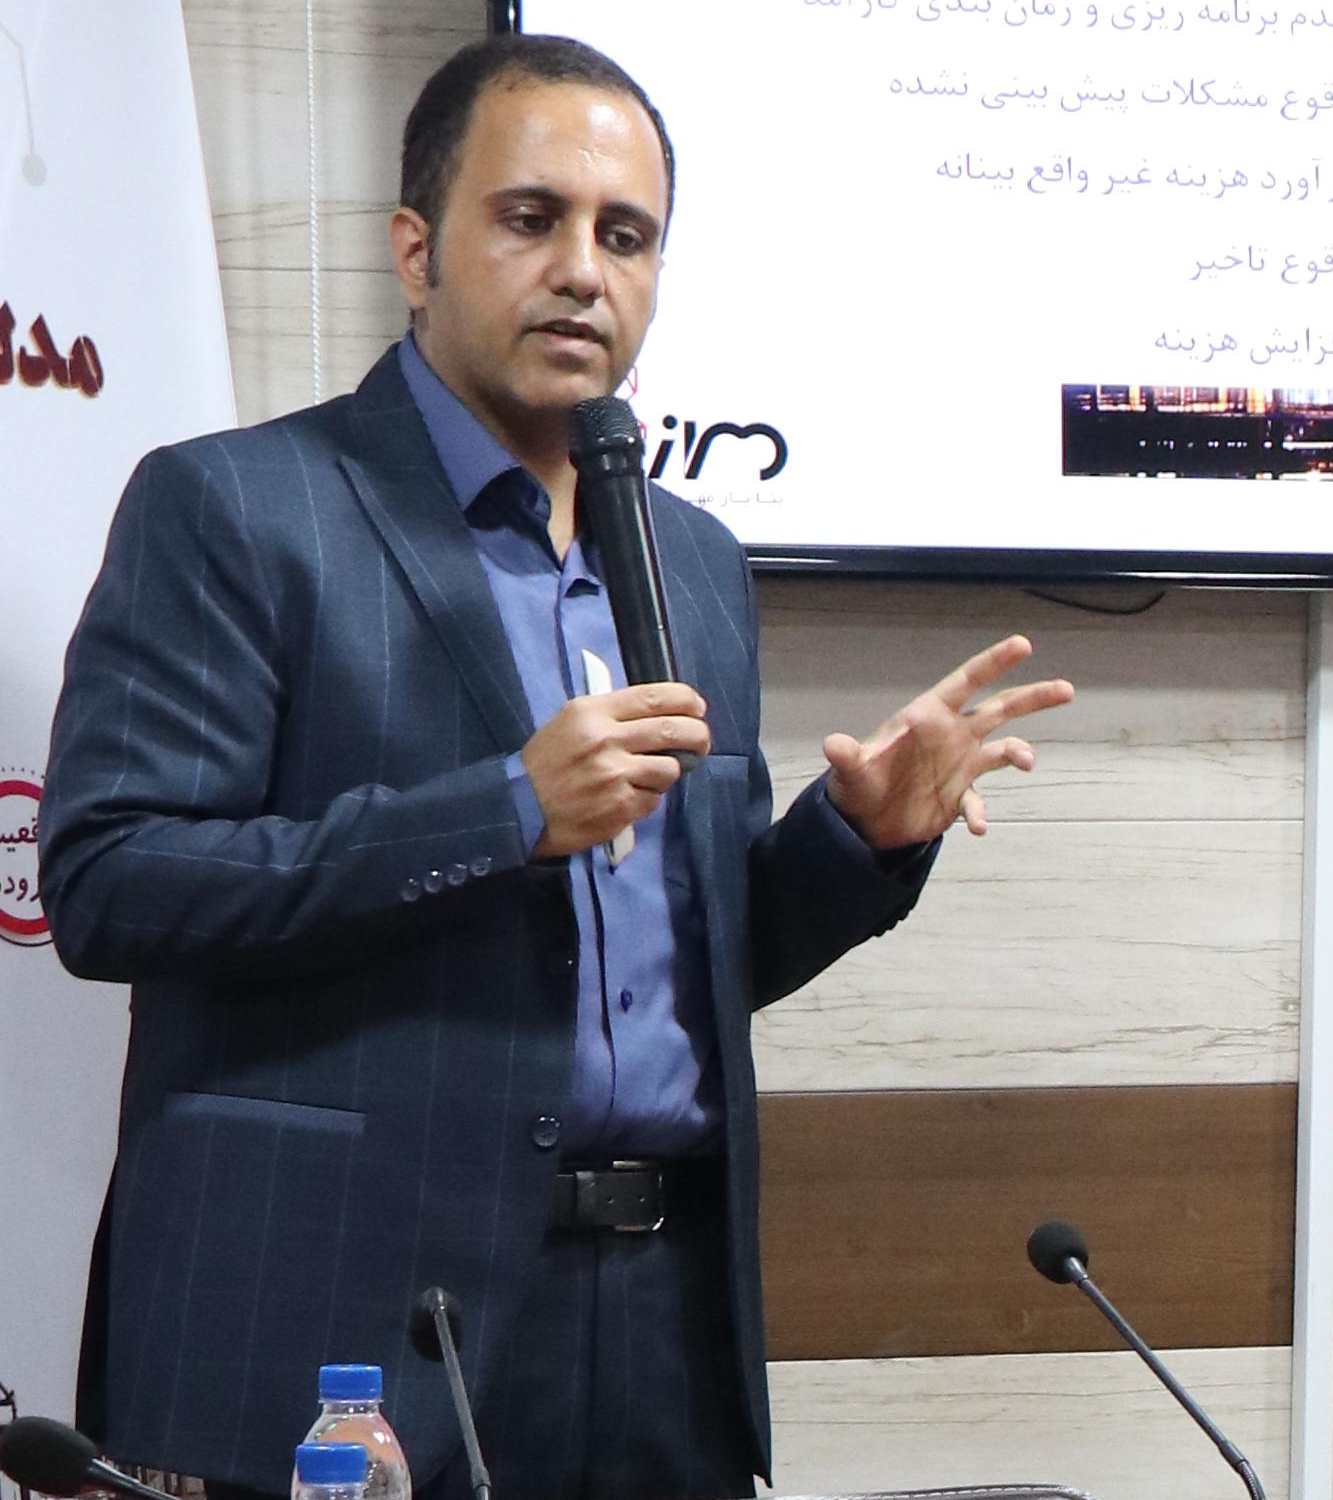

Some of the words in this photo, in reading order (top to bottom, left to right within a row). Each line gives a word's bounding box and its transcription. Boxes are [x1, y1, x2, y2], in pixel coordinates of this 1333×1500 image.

[1086, 4, 1099, 26] و
[1111, 0, 1185, 31] ریزی
[889, 68, 969, 97] نشده
[981, 80, 1049, 111] بینی
[1060, 72, 1126, 114] پیش
[1141, 77, 1269, 108] مشکلات
[936, 152, 1015, 190] بینانه
[1027, 153, 1089, 195] واقع
[1101, 158, 1152, 196] غیر
[1165, 162, 1249, 201] هزینه
[1190, 245, 1266, 281] تاخیر
[1154, 329, 1238, 363] هزینه
